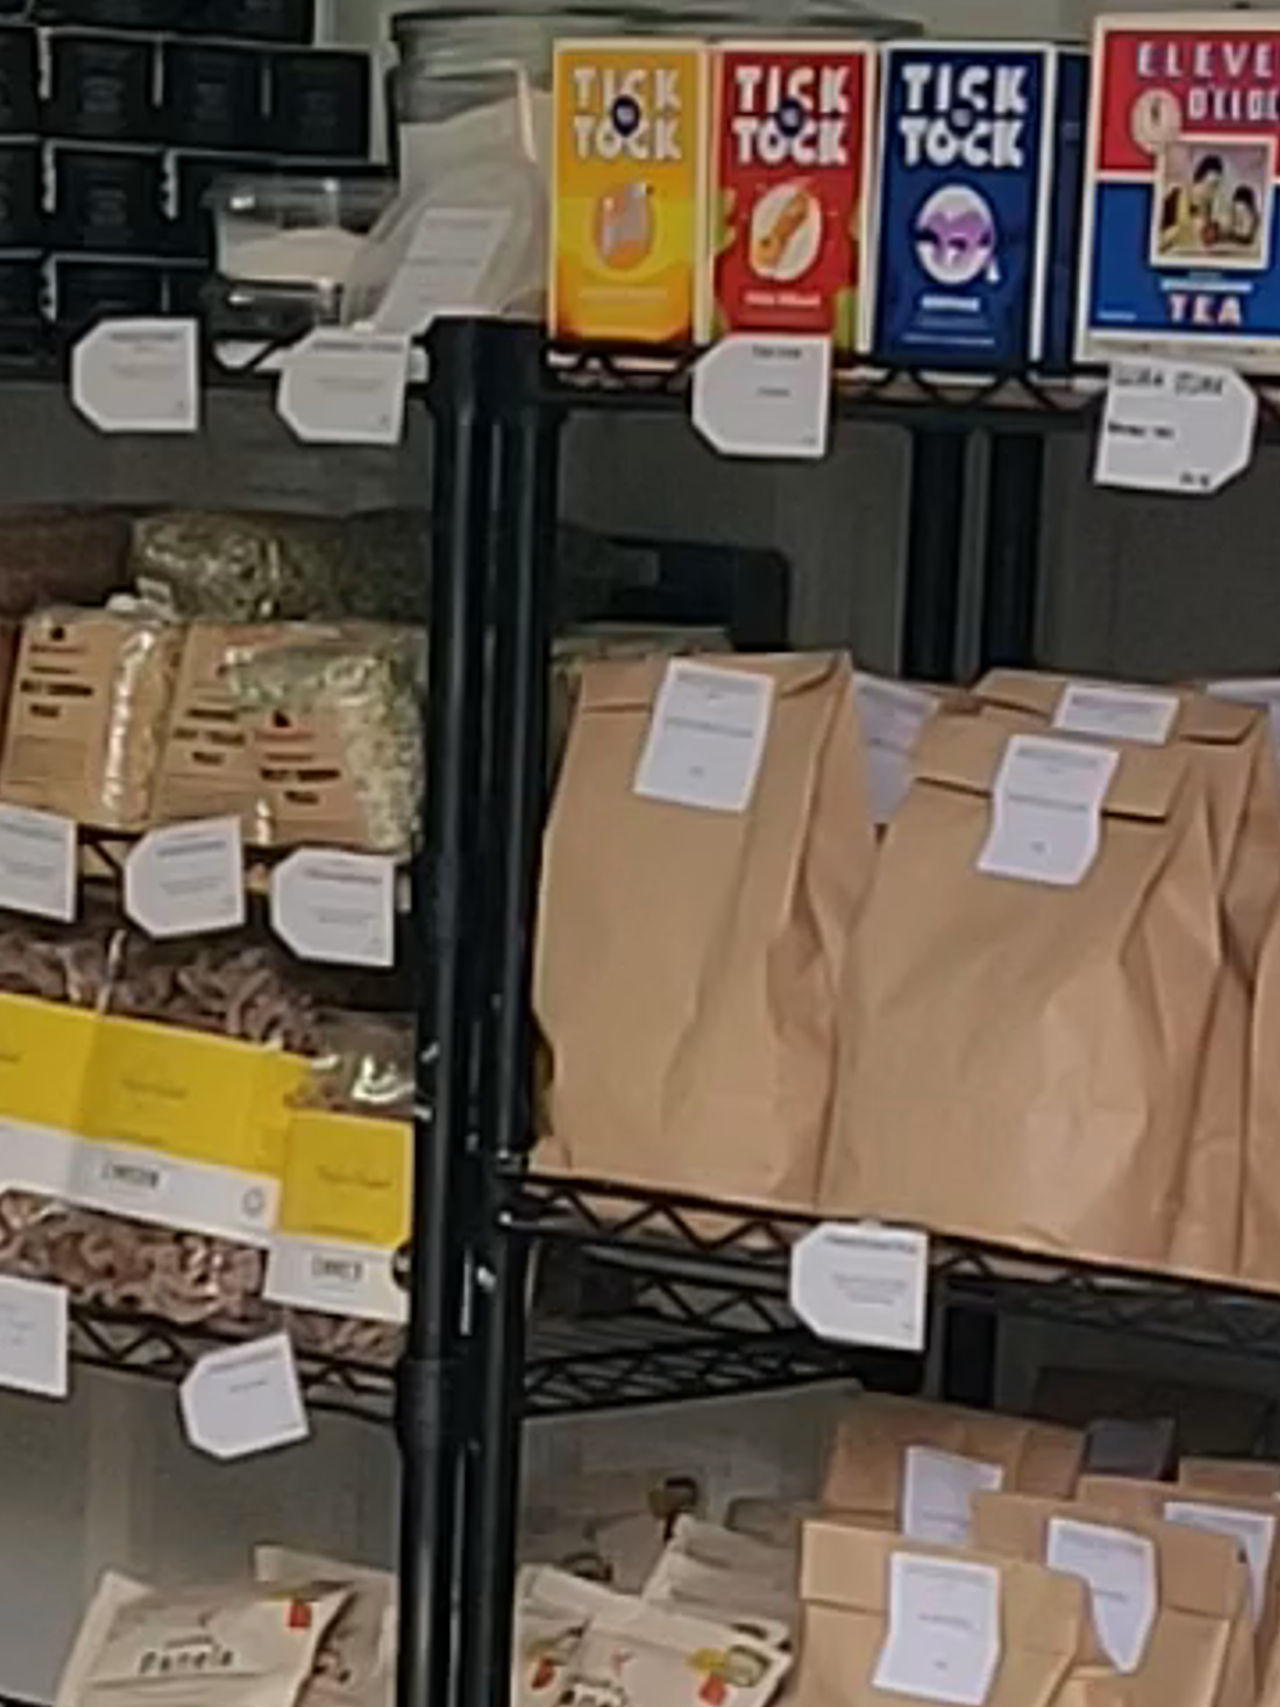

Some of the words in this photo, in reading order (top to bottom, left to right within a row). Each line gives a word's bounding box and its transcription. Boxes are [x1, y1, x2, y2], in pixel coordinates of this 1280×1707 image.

[573, 68, 683, 110] TICK
[734, 65, 851, 113] TICK
[900, 62, 1029, 114] TICK
[573, 115, 683, 161] TOCK
[731, 116, 850, 165] TOCK
[898, 116, 1025, 168] TOCK
[1169, 292, 1243, 327] TEA
[138, 1649, 236, 1675] Panela
